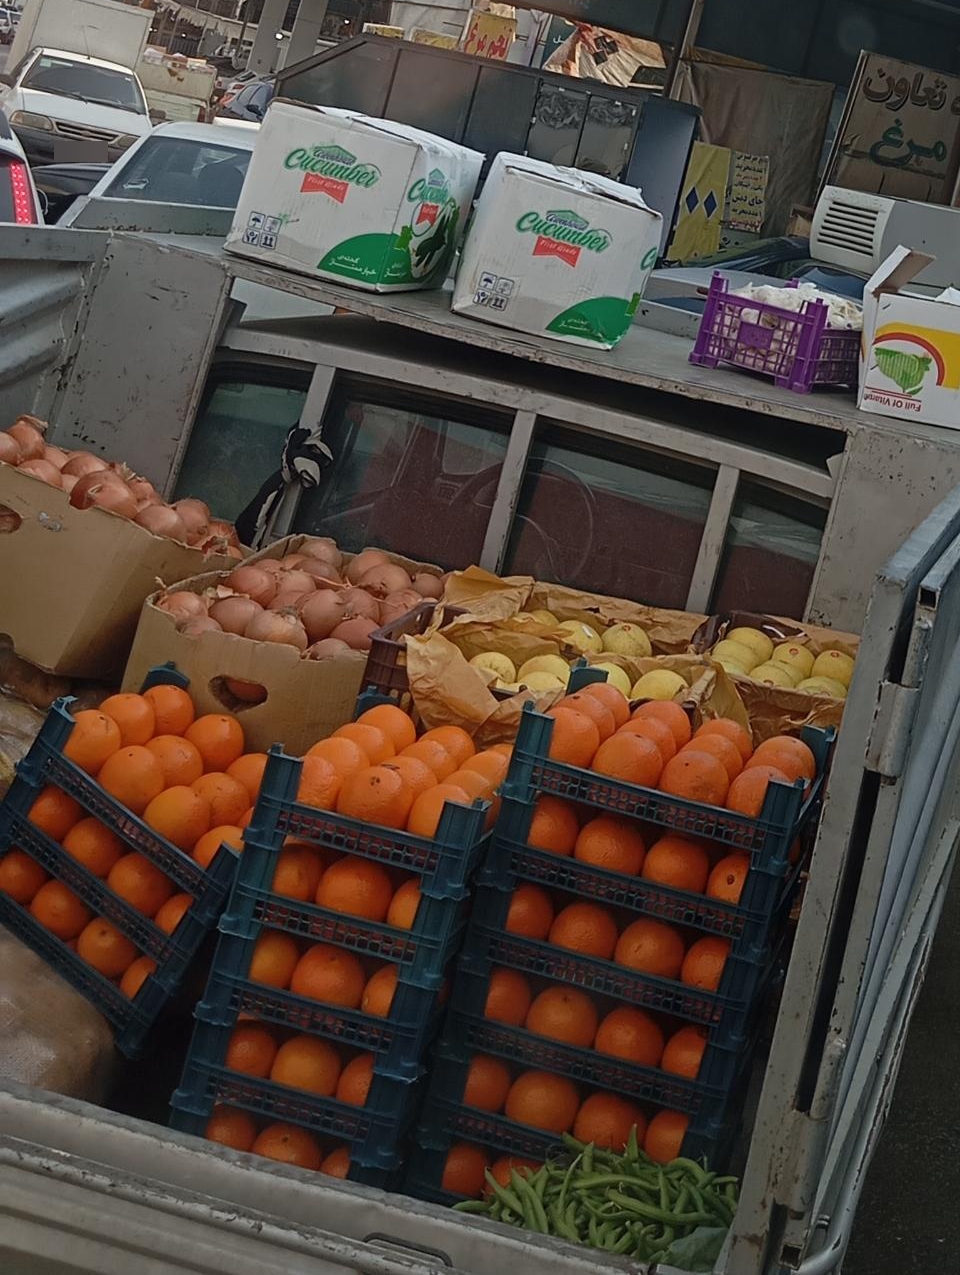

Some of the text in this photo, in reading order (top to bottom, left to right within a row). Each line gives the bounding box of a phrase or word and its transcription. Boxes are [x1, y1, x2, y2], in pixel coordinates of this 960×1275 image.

[862, 67, 948, 112] تعاون
[869, 117, 947, 167] مرغ
[284, 148, 382, 188] Cucumber
[515, 211, 613, 254] Cucumber
[892, 400, 904, 409] Of
[905, 402, 922, 412] Full
